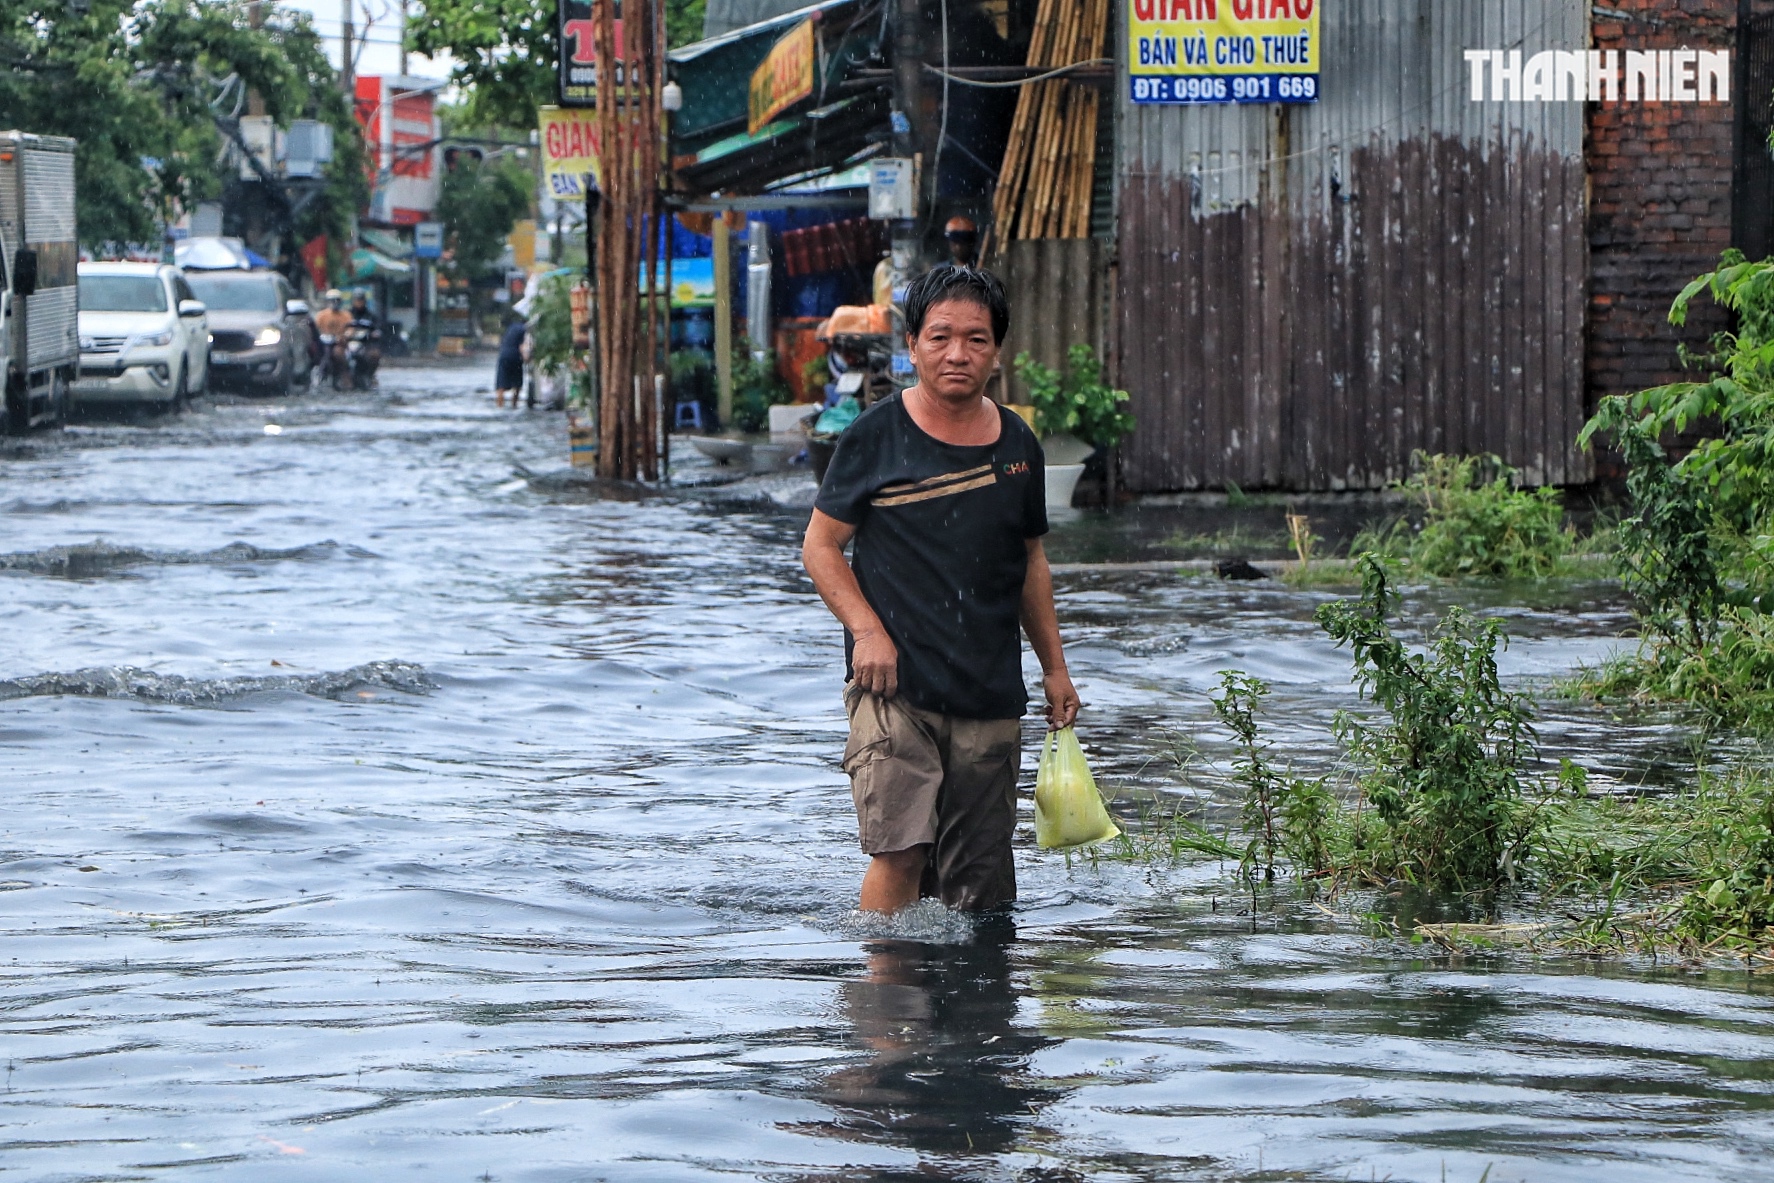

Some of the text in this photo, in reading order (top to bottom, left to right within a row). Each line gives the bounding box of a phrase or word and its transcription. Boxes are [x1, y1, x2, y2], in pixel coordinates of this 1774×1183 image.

[1139, 28, 1309, 65] BÁN VÀ CHO THUÊ
[1134, 76, 1316, 99] ĐT: 0906 901 669
